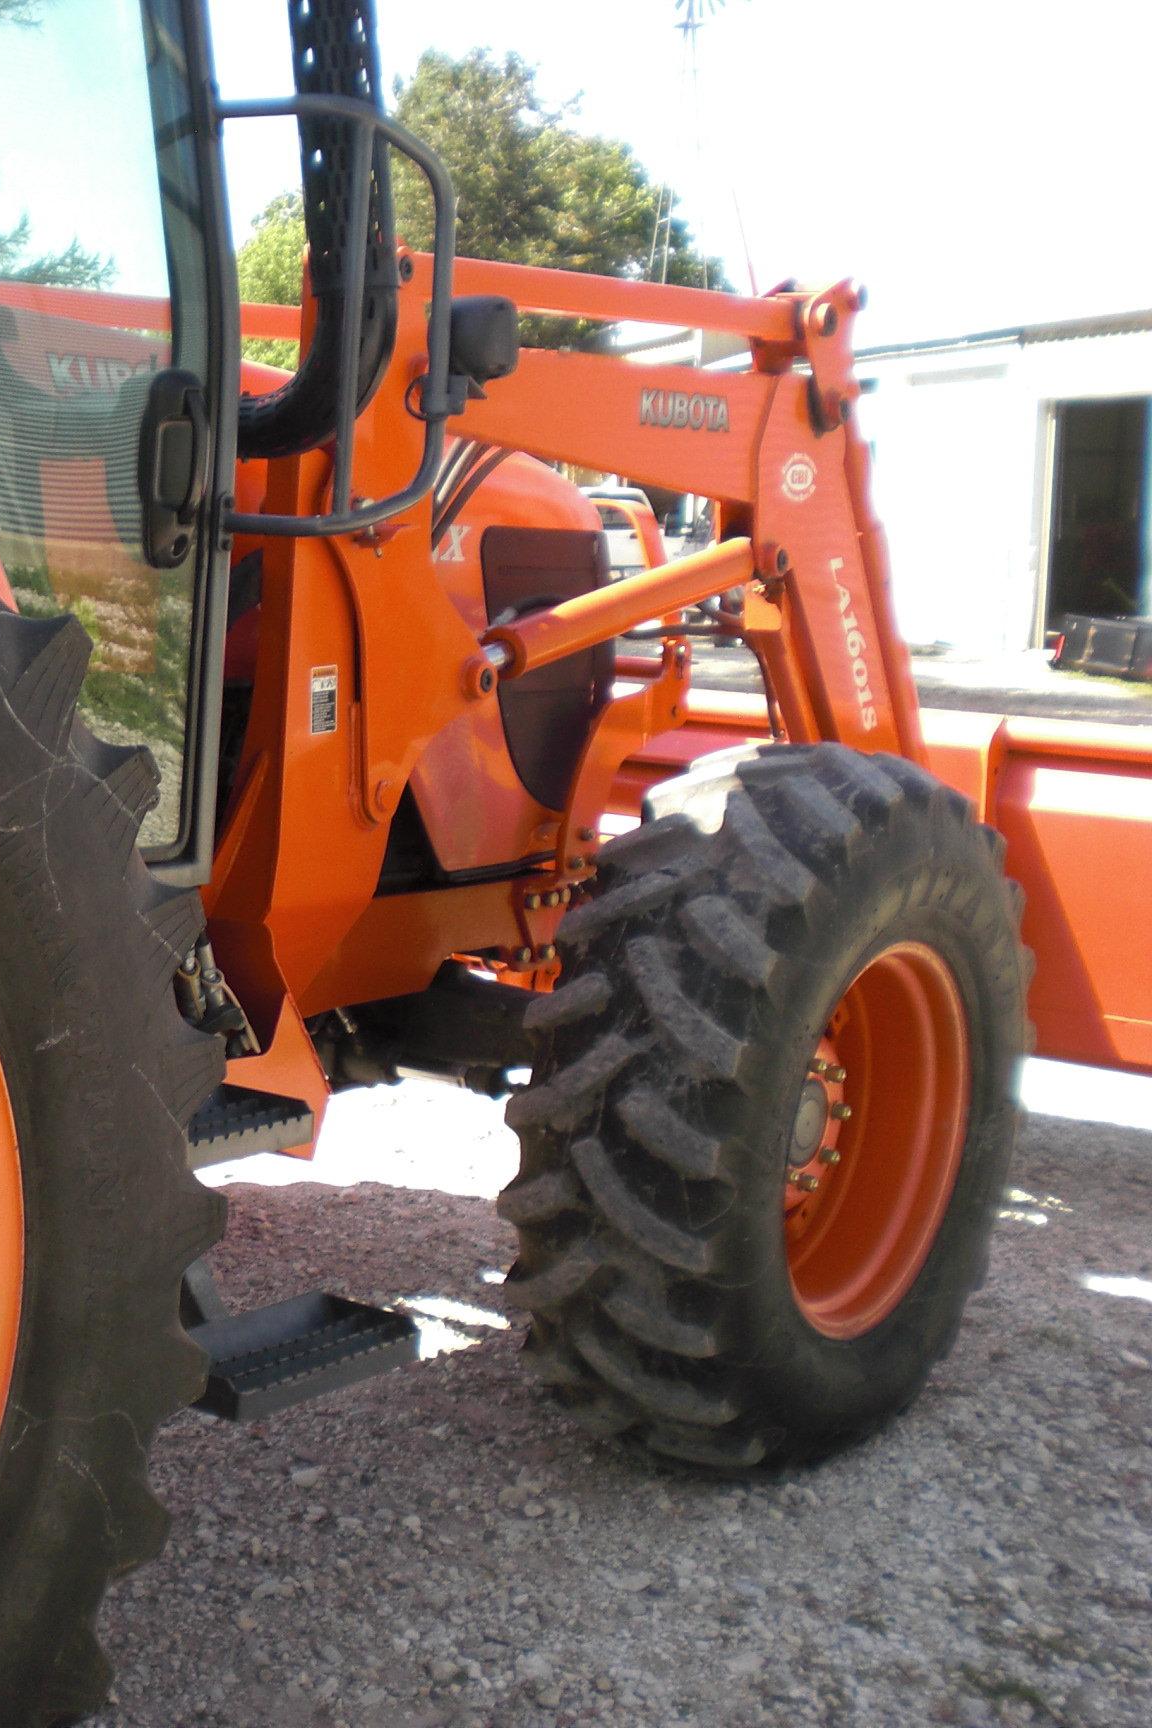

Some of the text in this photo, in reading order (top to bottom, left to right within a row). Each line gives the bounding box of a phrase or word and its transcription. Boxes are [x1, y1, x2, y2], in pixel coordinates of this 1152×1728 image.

[639, 388, 730, 432] KUBOTA
[432, 525, 472, 563] X
[829, 556, 878, 732] LA1601S
